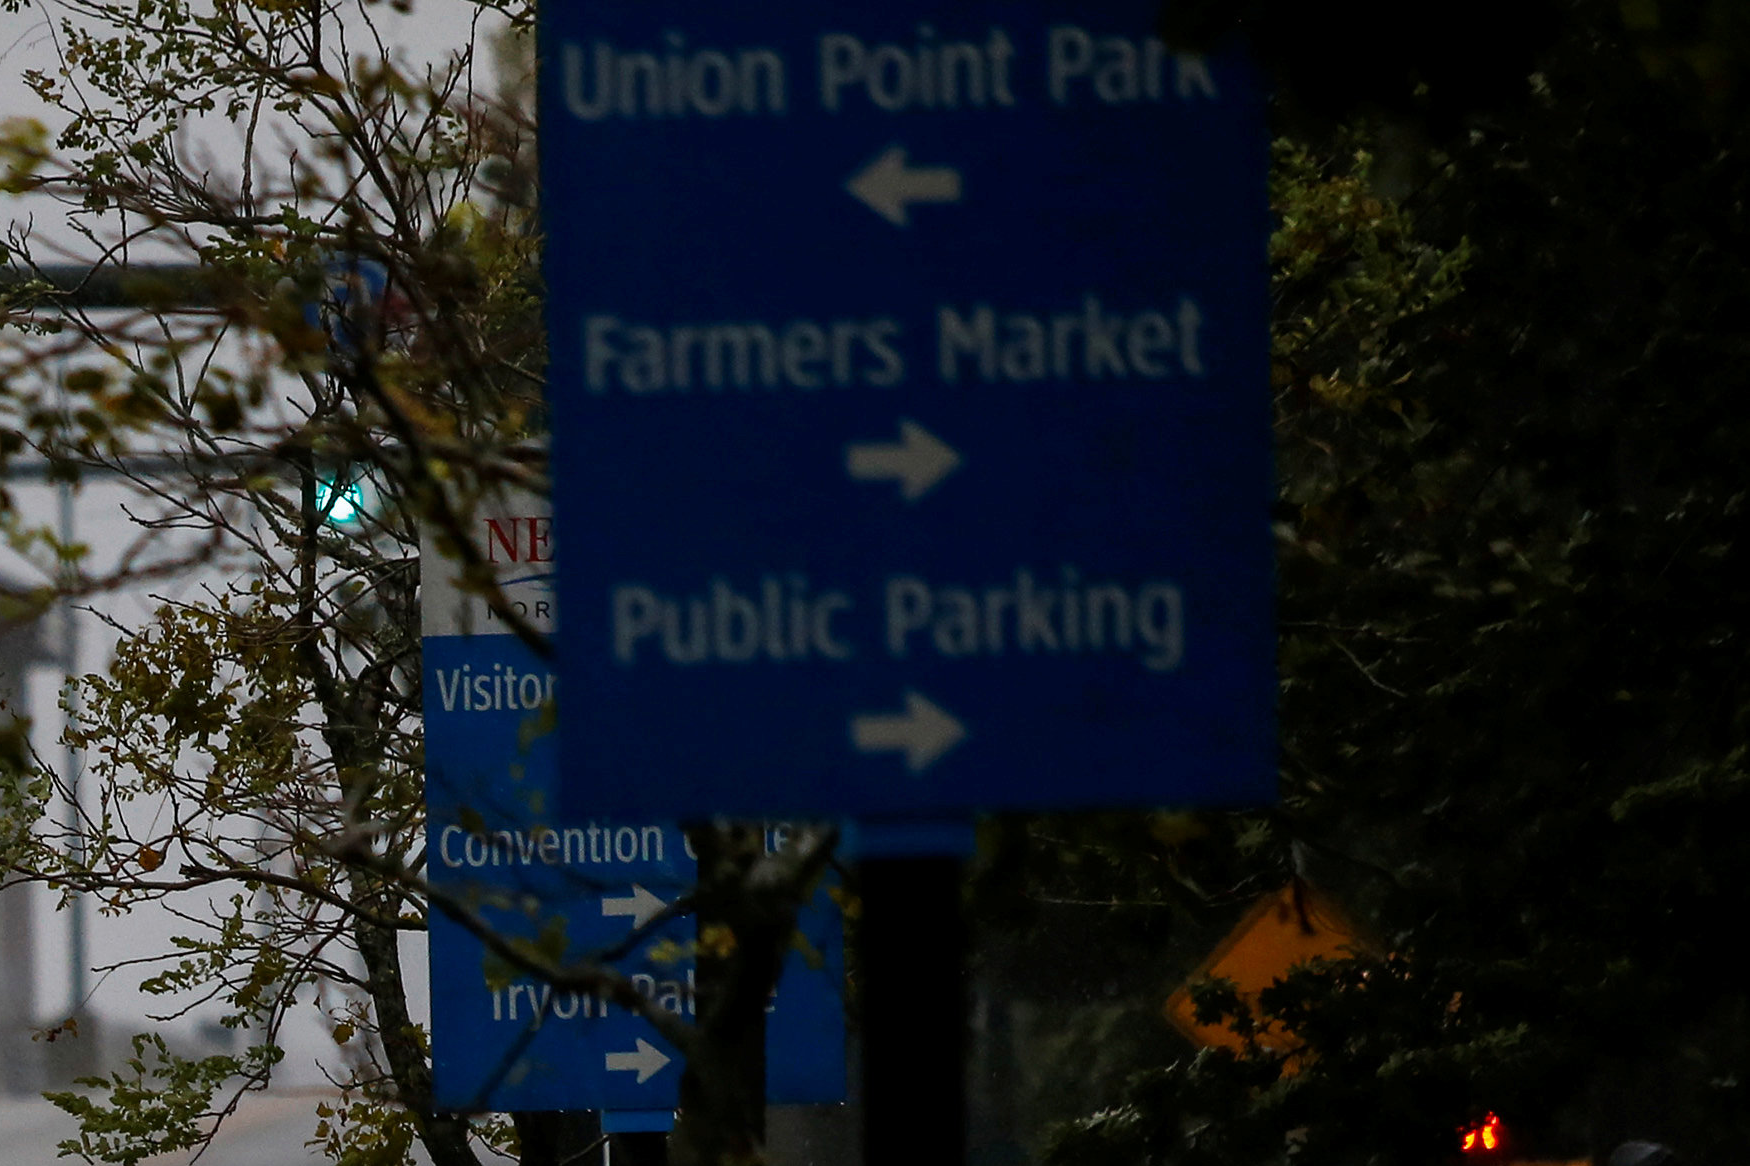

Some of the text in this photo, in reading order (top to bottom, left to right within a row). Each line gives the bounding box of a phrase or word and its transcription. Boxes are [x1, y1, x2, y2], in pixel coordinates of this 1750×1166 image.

[560, 22, 1218, 120] Union Point Park
[584, 294, 1204, 393] Farmers Market
[611, 562, 1186, 672] Public Parking
[439, 820, 664, 868] Convention
